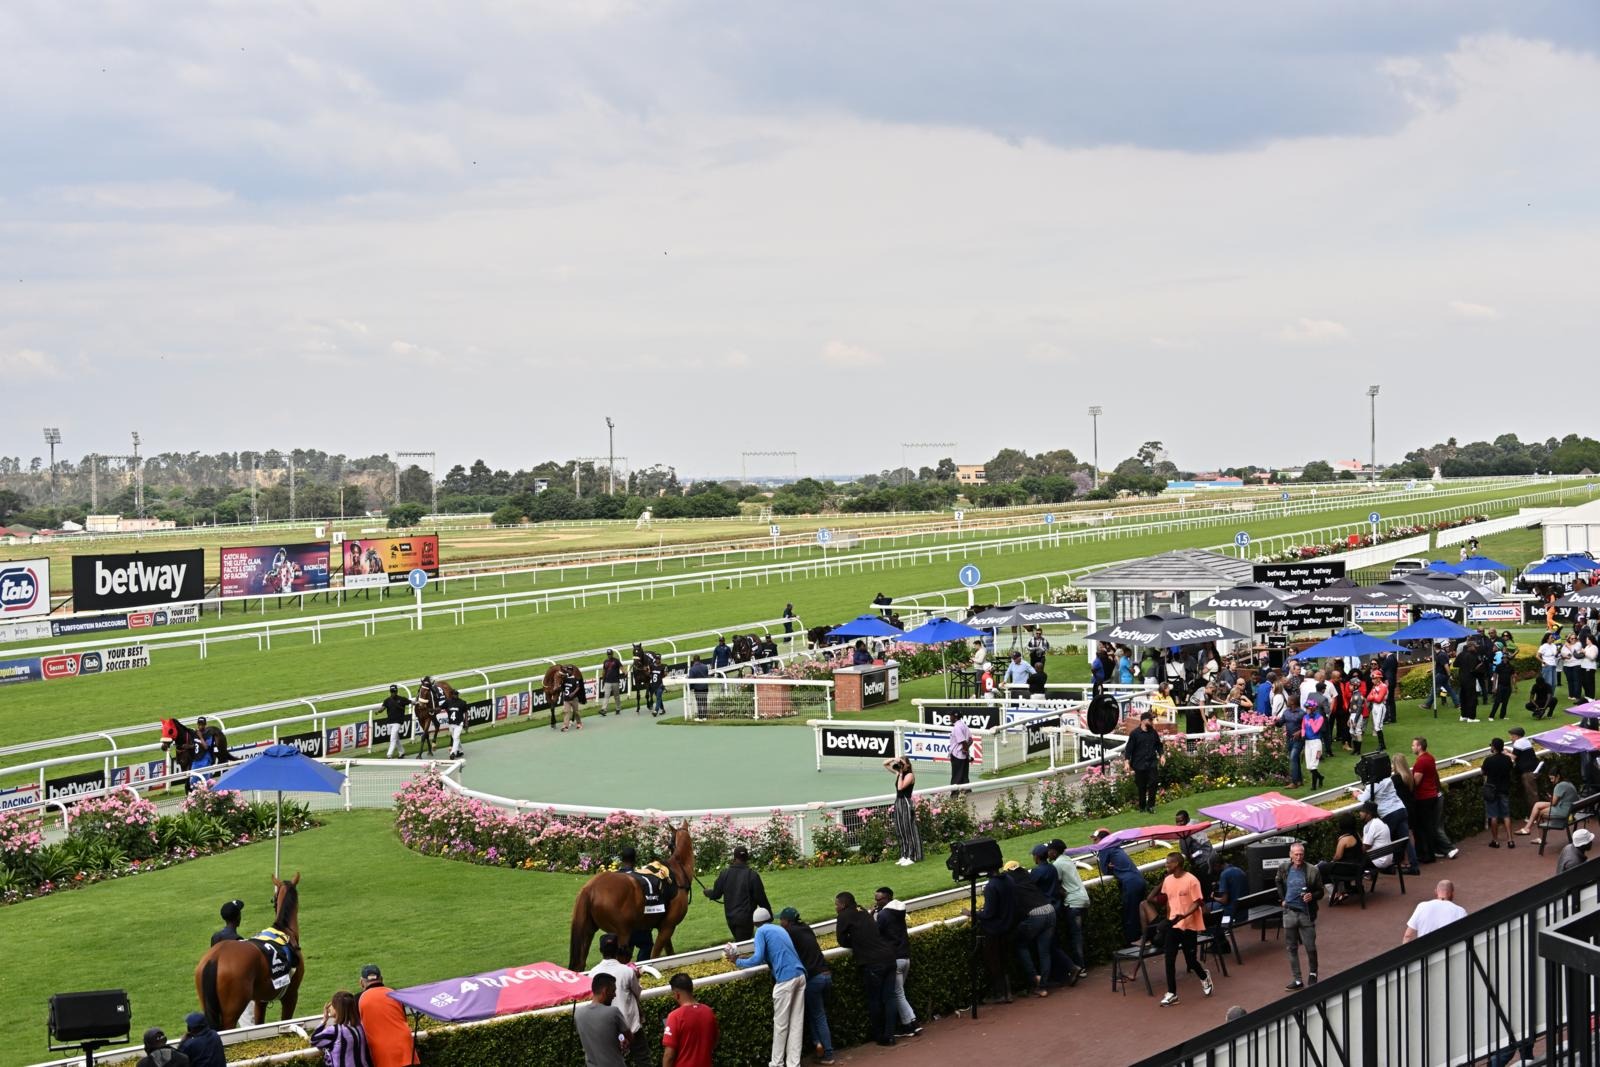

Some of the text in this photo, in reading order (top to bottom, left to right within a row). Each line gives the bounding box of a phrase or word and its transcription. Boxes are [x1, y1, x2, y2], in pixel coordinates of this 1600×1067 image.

[956, 511, 962, 519] 2
[1237, 534, 1248, 544] 1.5
[95, 560, 187, 598] betway
[414, 572, 420, 585] 1
[966, 569, 972, 583] 1
[1, 578, 34, 600] tab
[1208, 597, 1274, 609] betway
[1312, 594, 1352, 602] betway
[968, 614, 1012, 626] betway
[1019, 610, 1070, 621] betway
[61, 620, 127, 631] TURFFONTEIN RACECOURSE
[1109, 626, 1159, 643] betway
[1167, 626, 1224, 641] betway
[107, 646, 144, 659] YOUR BEST
[85, 658, 99, 668] tab
[105, 657, 148, 672] SOCCER BETS
[652, 674, 658, 682] 6
[564, 687, 570, 696] 5
[864, 681, 885, 696] betway
[450, 711, 457, 721] 4
[467, 704, 491, 721] etway
[933, 711, 991, 729] beway
[194, 743, 200, 754] 3
[826, 732, 889, 754] betway
[925, 743, 951, 753] 4 RAC
[641, 875, 653, 894] 1
[264, 942, 282, 966] 2
[460, 968, 580, 994] 4 RACING
